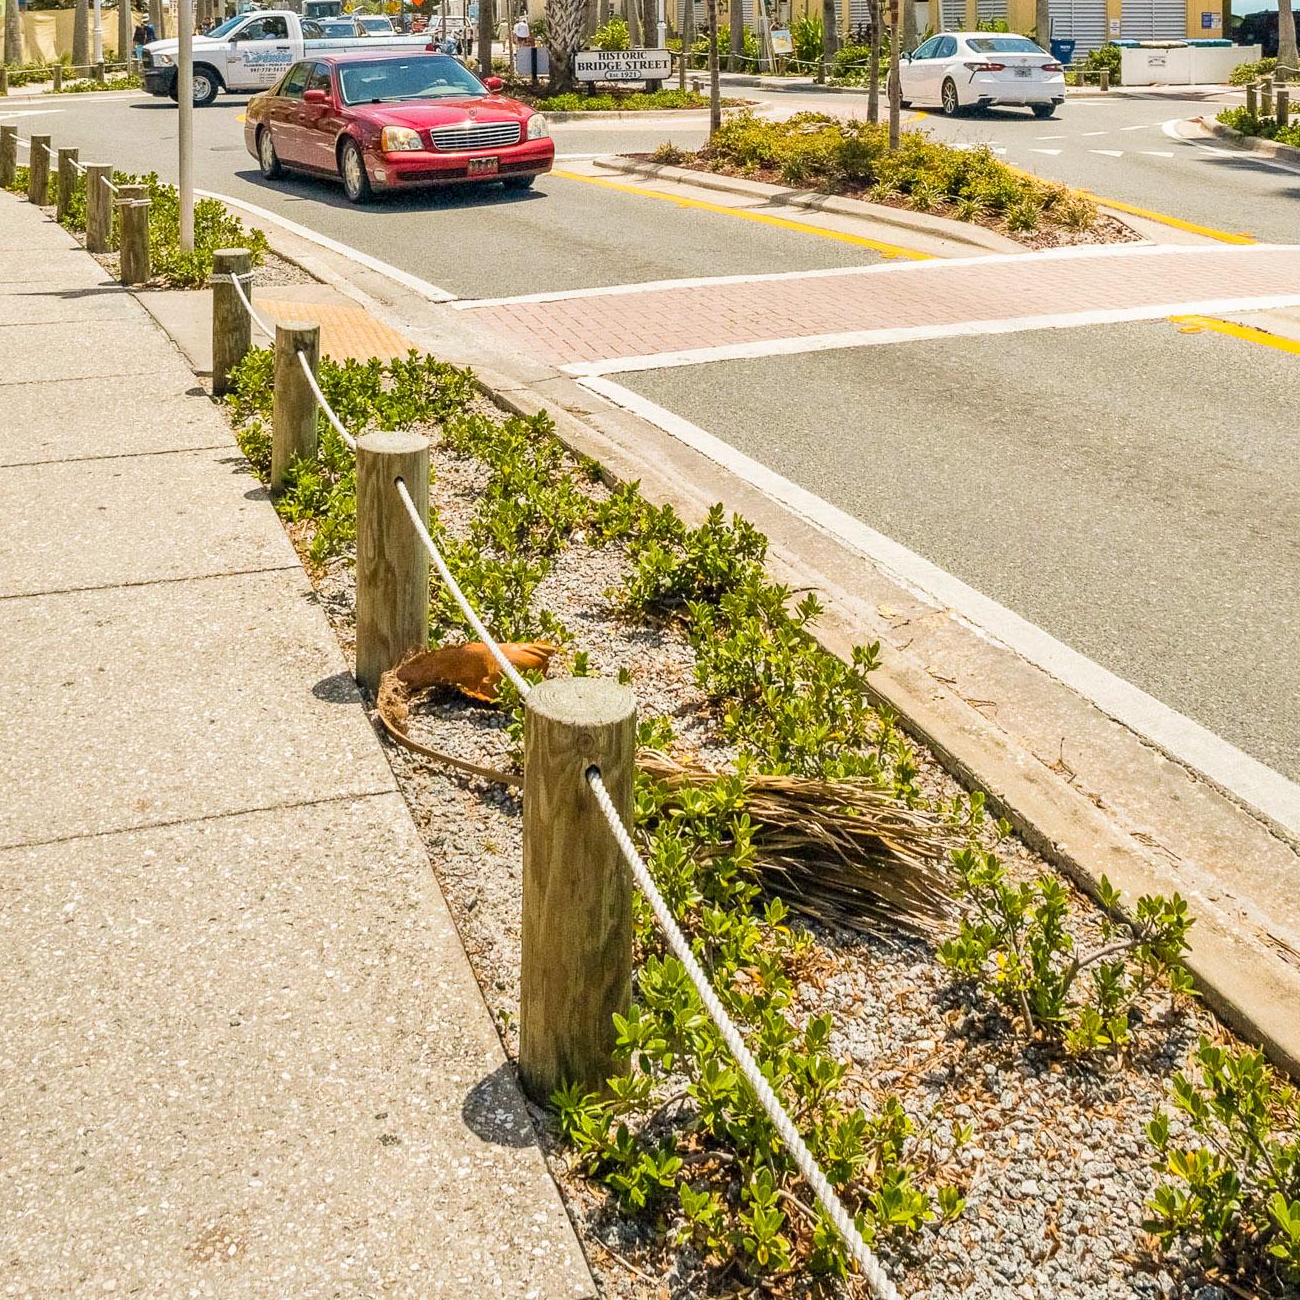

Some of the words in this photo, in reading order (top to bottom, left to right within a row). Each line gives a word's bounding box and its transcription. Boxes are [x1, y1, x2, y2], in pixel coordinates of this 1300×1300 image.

[598, 51, 648, 61] HISTORIC
[577, 60, 622, 71] BRIDGE
[625, 60, 670, 70] STREET
